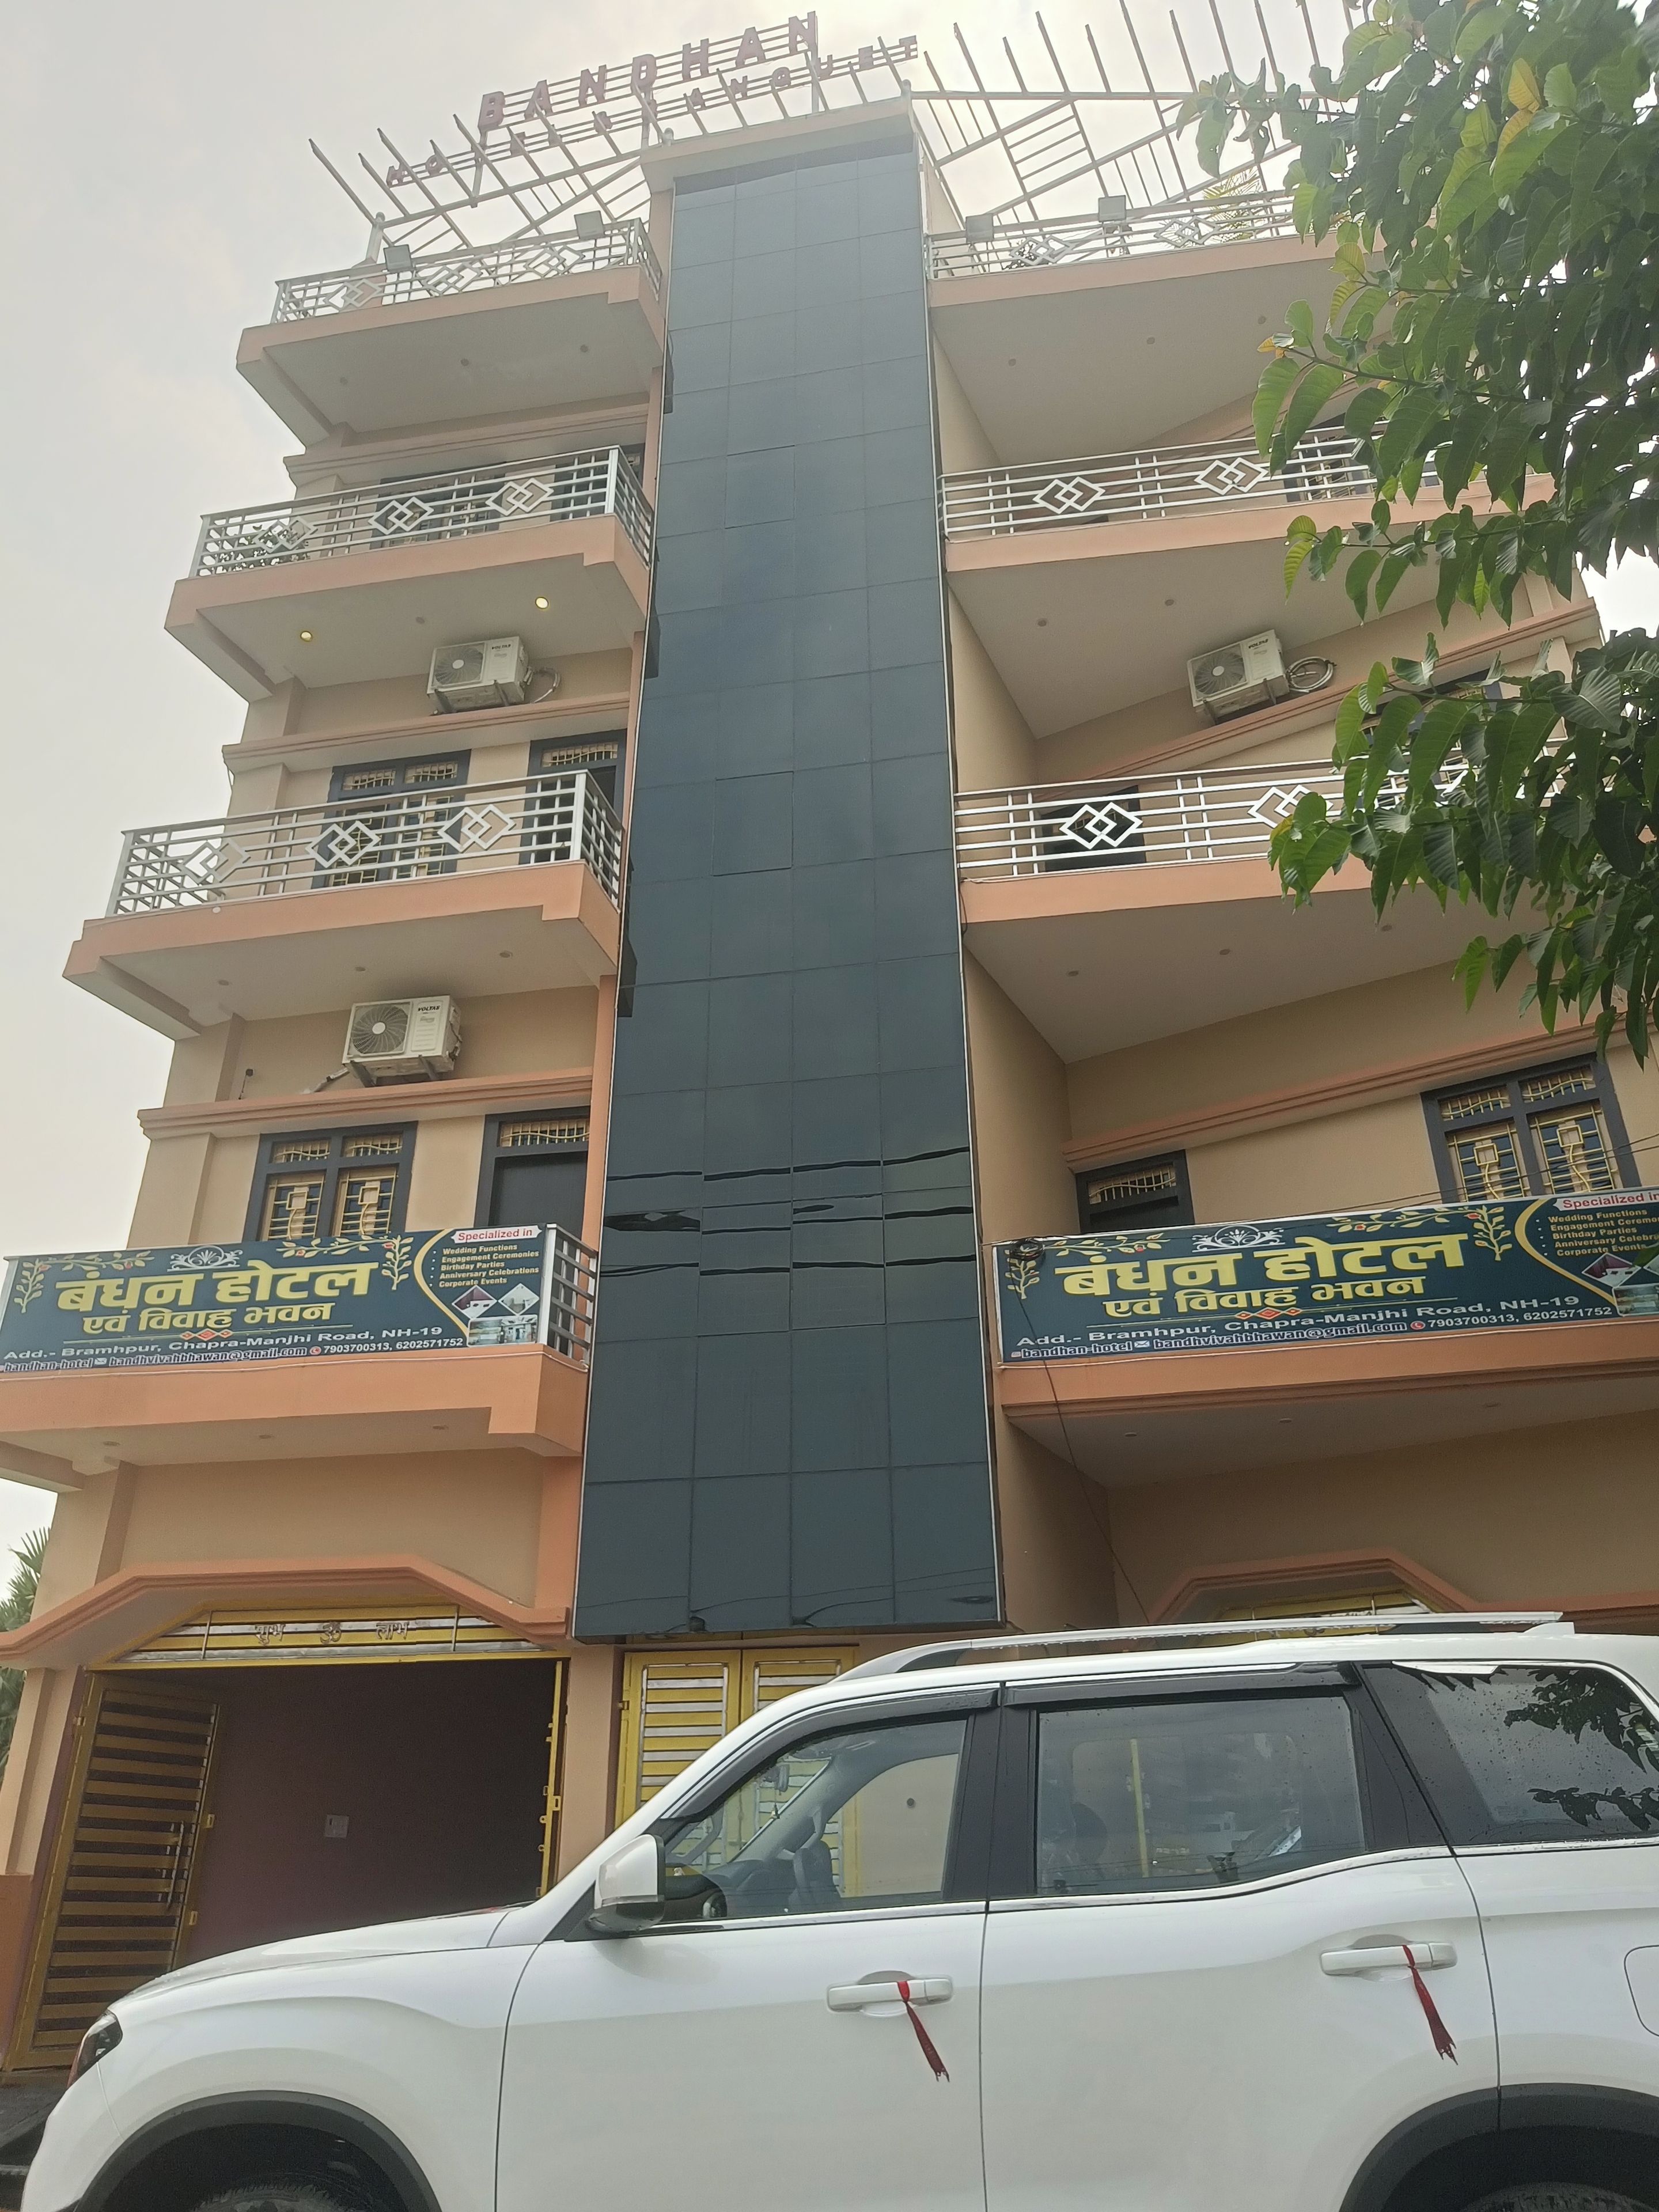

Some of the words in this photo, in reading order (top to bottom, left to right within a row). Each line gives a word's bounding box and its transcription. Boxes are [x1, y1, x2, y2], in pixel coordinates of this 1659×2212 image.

[478, 10, 817, 131] BANDHAN
[386, 124, 562, 188] HOEL
[1563, 1193, 1645, 1210] Specialized
[1548, 1214, 1593, 1224] Wedding
[1596, 1210, 1647, 1219] Functions
[1550, 1220, 1615, 1232] Engagement
[1618, 1217, 1659, 1226] Ceremo
[458, 1229, 519, 1243] Specialized
[522, 1228, 532, 1237] in
[1553, 1230, 1596, 1240] Birthday
[1599, 1227, 1637, 1236] Parties
[442, 1247, 477, 1256] Wedding
[479, 1244, 517, 1252] Functions
[1555, 1238, 1616, 1248] Anniversary
[1557, 1247, 1609, 1257] Corporate
[1611, 1243, 1646, 1252] Events
[441, 1254, 490, 1264] Engagement
[493, 1251, 539, 1260] Ceremonies
[1054, 1252, 1243, 1296] बंधन
[1253, 1233, 1468, 1280] होटल
[440, 1271, 487, 1280] Anniversary
[488, 1267, 539, 1276] Celebrations
[441, 1263, 475, 1272] Birthday
[476, 1261, 505, 1269] Parties
[55, 1271, 204, 1312] बंधन
[212, 1259, 379, 1303] होटल
[439, 1279, 479, 1288] Corporate
[1102, 1291, 1163, 1320] एवं
[1174, 1286, 1299, 1314] विवाह
[1311, 1276, 1426, 1301] भवन
[82, 1306, 131, 1334] एवं
[139, 1306, 237, 1332] विवाह
[244, 1302, 335, 1324] भवन
[1088, 1325, 1216, 1341] Bramhpur,
[1224, 1308, 1408, 1331] Chapra-Manjhi
[1416, 1302, 1491, 1316] Road,
[1499, 1296, 1580, 1310] NH-19
[1021, 1340, 1133, 1359] bandhan-hotel
[1153, 1321, 1407, 1350] bandhvivahbhawan@gmail.com
[1427, 1313, 1520, 1328] 7903700313,
[1522, 1306, 1613, 1321] 6202571752
[61, 1344, 162, 1356] Bramhpur,
[169, 1334, 311, 1350] Chapra-Manjhi
[317, 1331, 374, 1342] Road,
[381, 1327, 442, 1338] NH-19
[323, 1343, 392, 1354] 7903700313,
[396, 1338, 463, 1350] 6202571752
[254, 1623, 286, 1646] शुभ
[376, 1621, 410, 1641] लाभ
